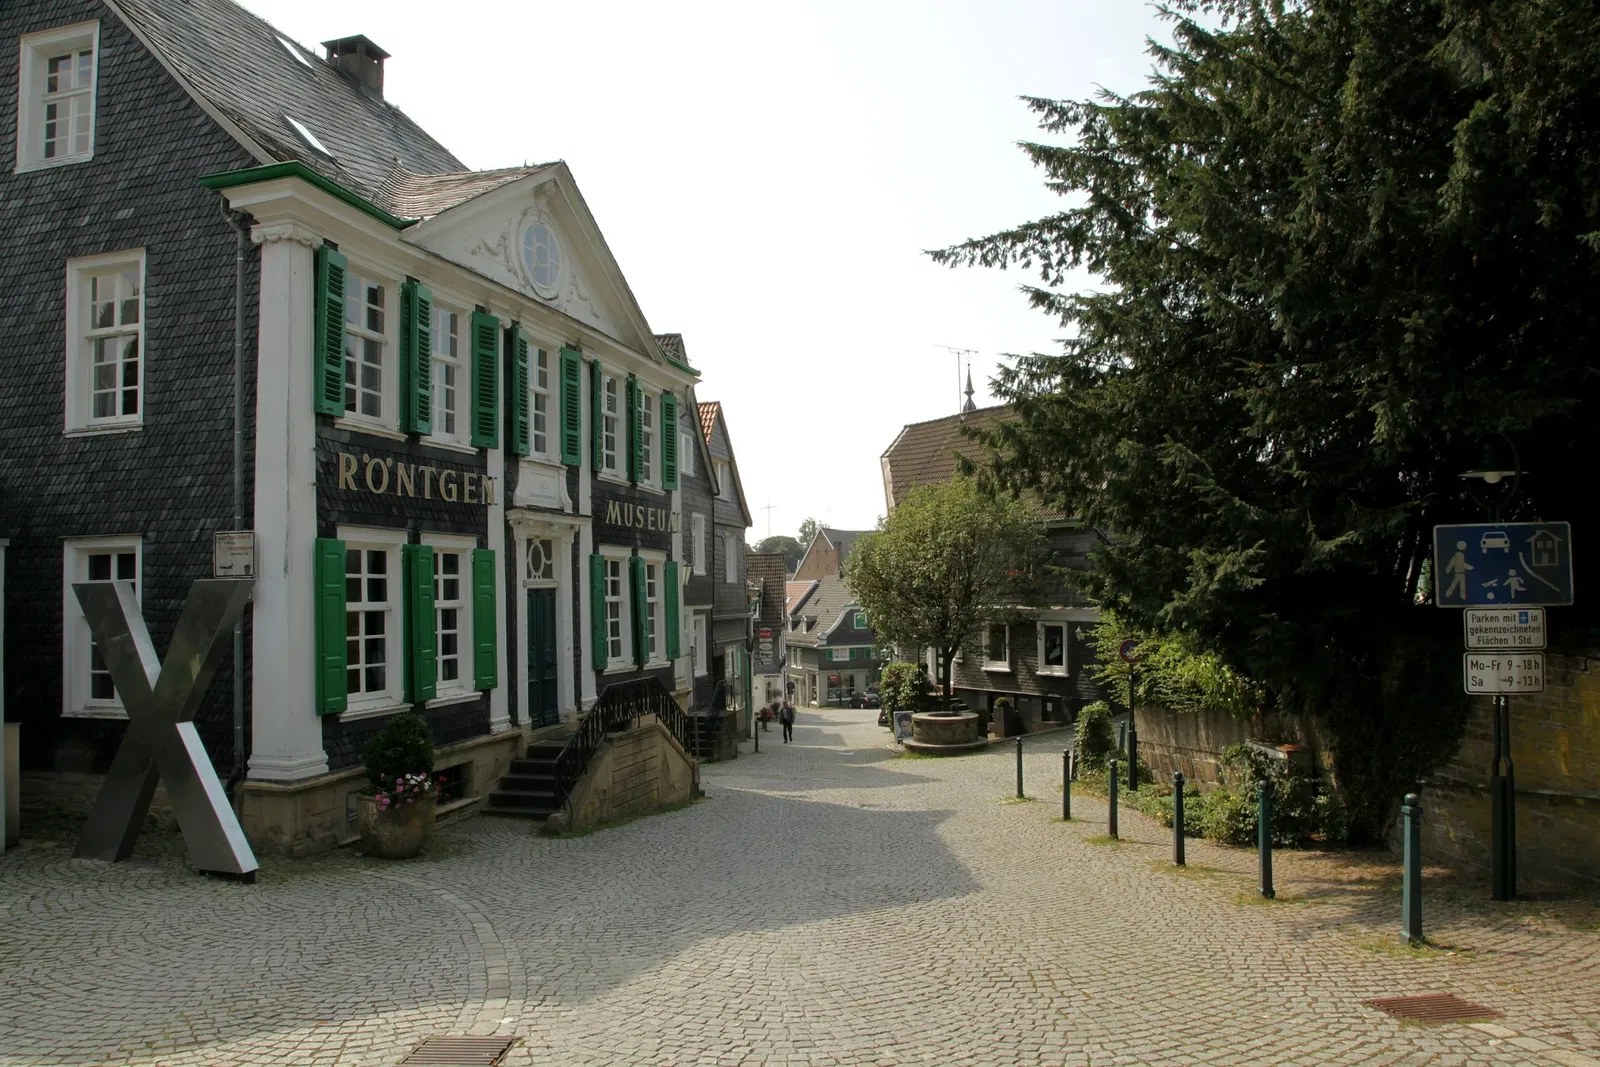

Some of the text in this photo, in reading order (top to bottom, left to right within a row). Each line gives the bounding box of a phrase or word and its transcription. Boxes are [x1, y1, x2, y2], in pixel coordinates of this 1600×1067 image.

[338, 452, 496, 505] RÖNTGEN
[606, 500, 681, 533] MUSEUM
[1471, 613, 1538, 622] Parken mit in
[1469, 625, 1541, 636] gekennzeichneten
[1477, 636, 1534, 645] Flächen 1 Std.
[1507, 660, 1512, 670] 9
[1471, 676, 1484, 686] Sa
